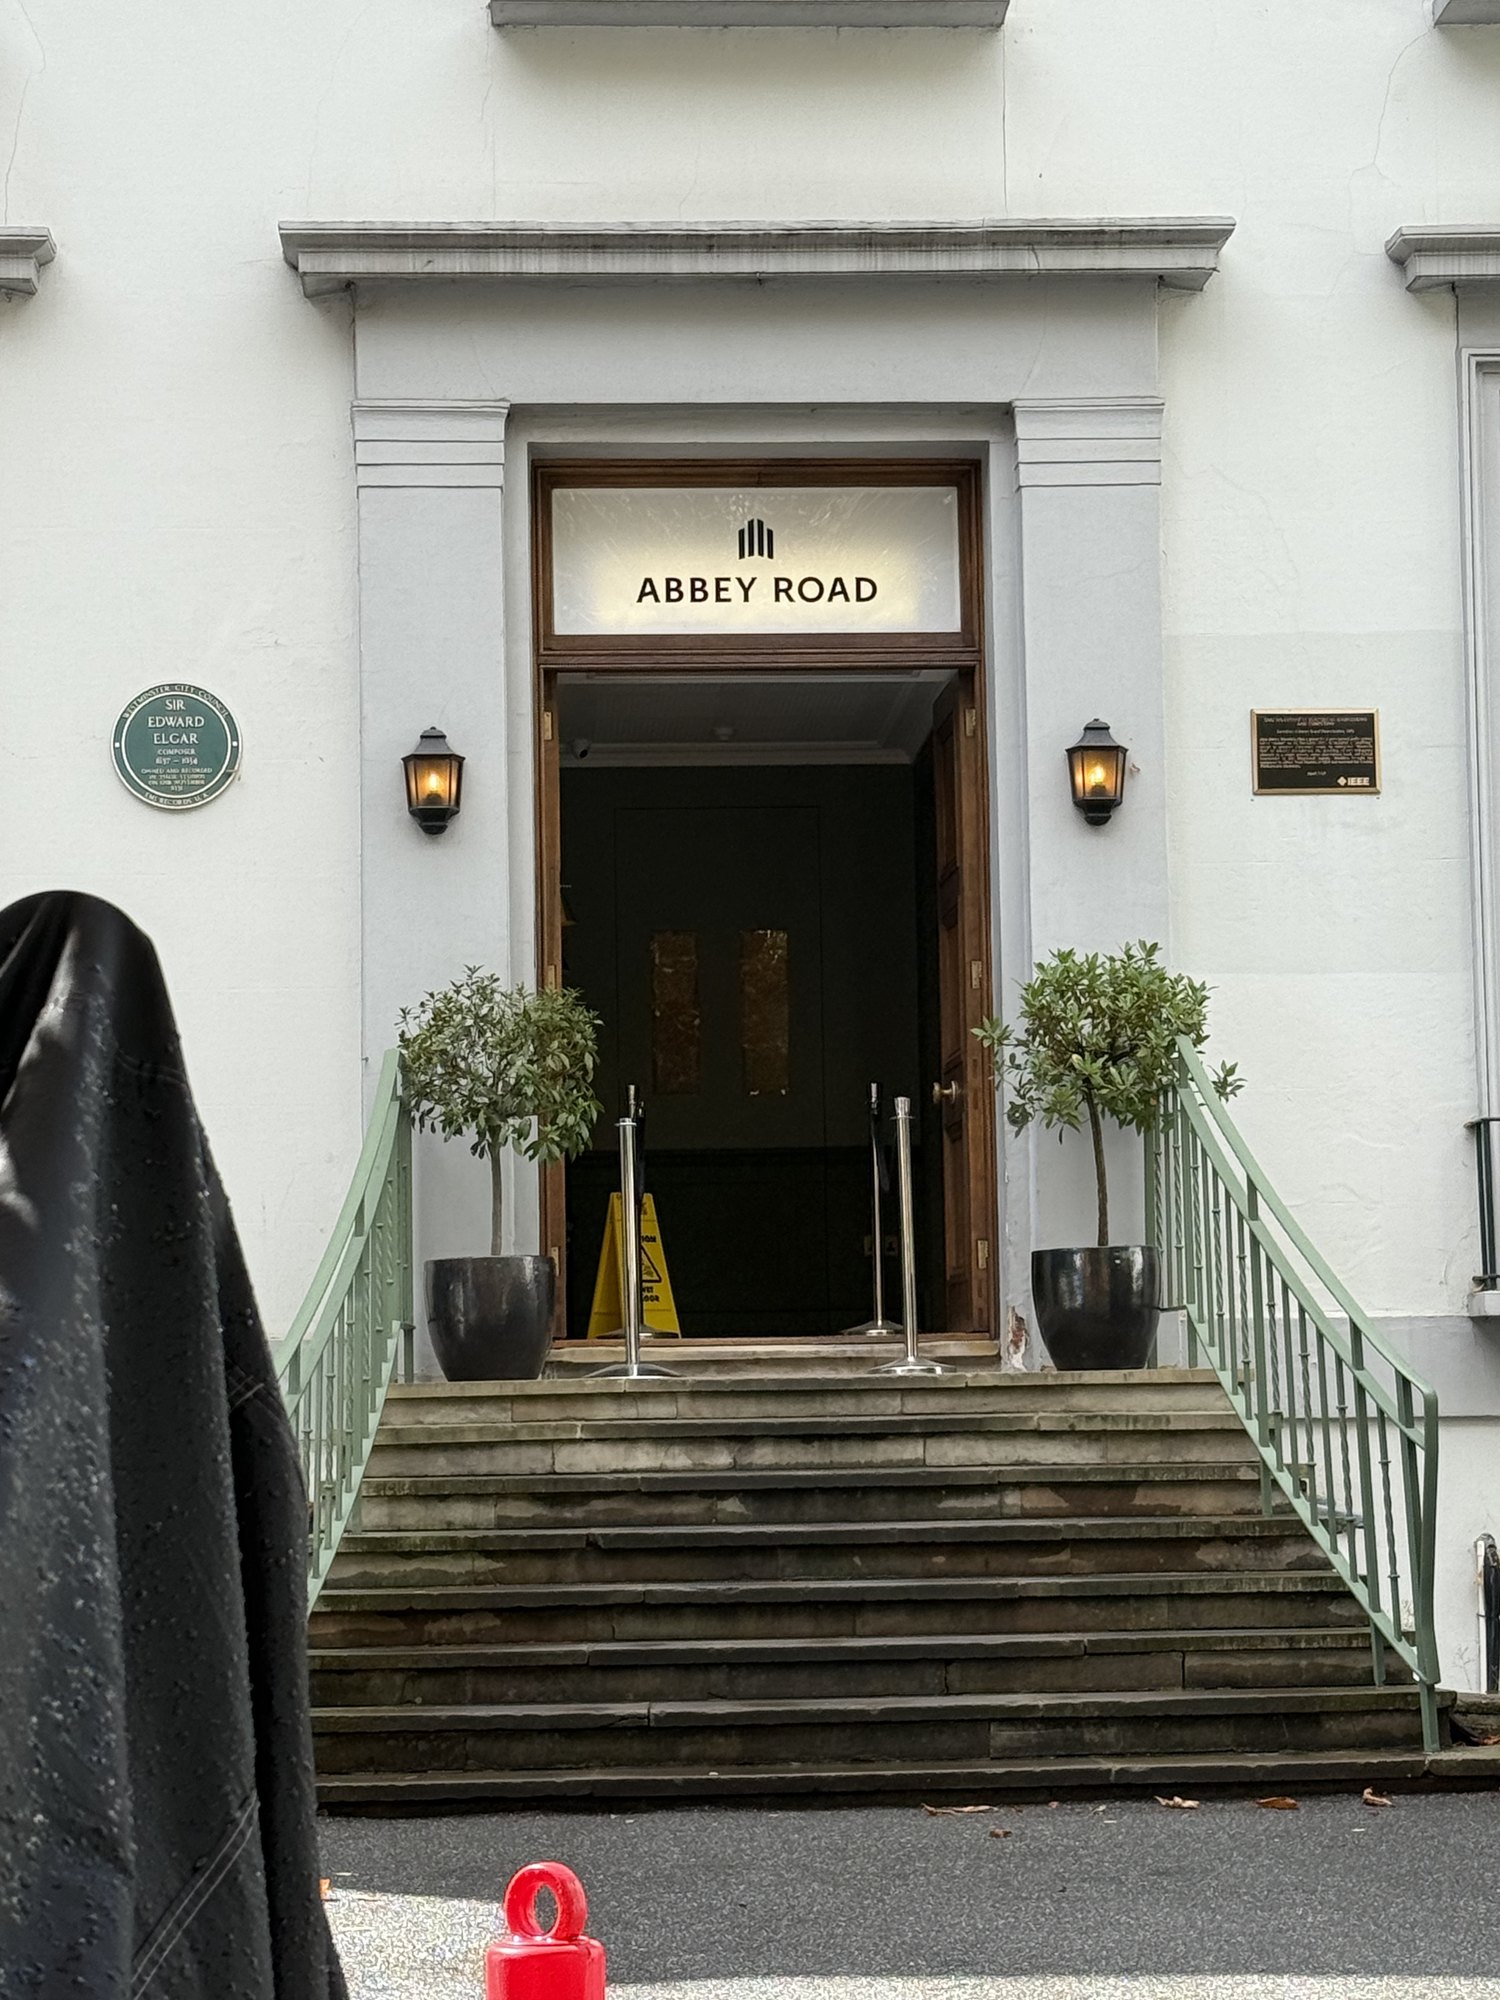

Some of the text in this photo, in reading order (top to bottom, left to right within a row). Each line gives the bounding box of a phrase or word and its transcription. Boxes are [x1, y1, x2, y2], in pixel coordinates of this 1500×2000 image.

[636, 576, 878, 603] ABBEY ROAD
[123, 685, 229, 718] WESTMINSTER CITY COUNCIL
[165, 699, 186, 711] SIR
[147, 716, 205, 728] EDWARD
[153, 733, 199, 745] ELGAR
[1347, 776, 1370, 786] IEEE
